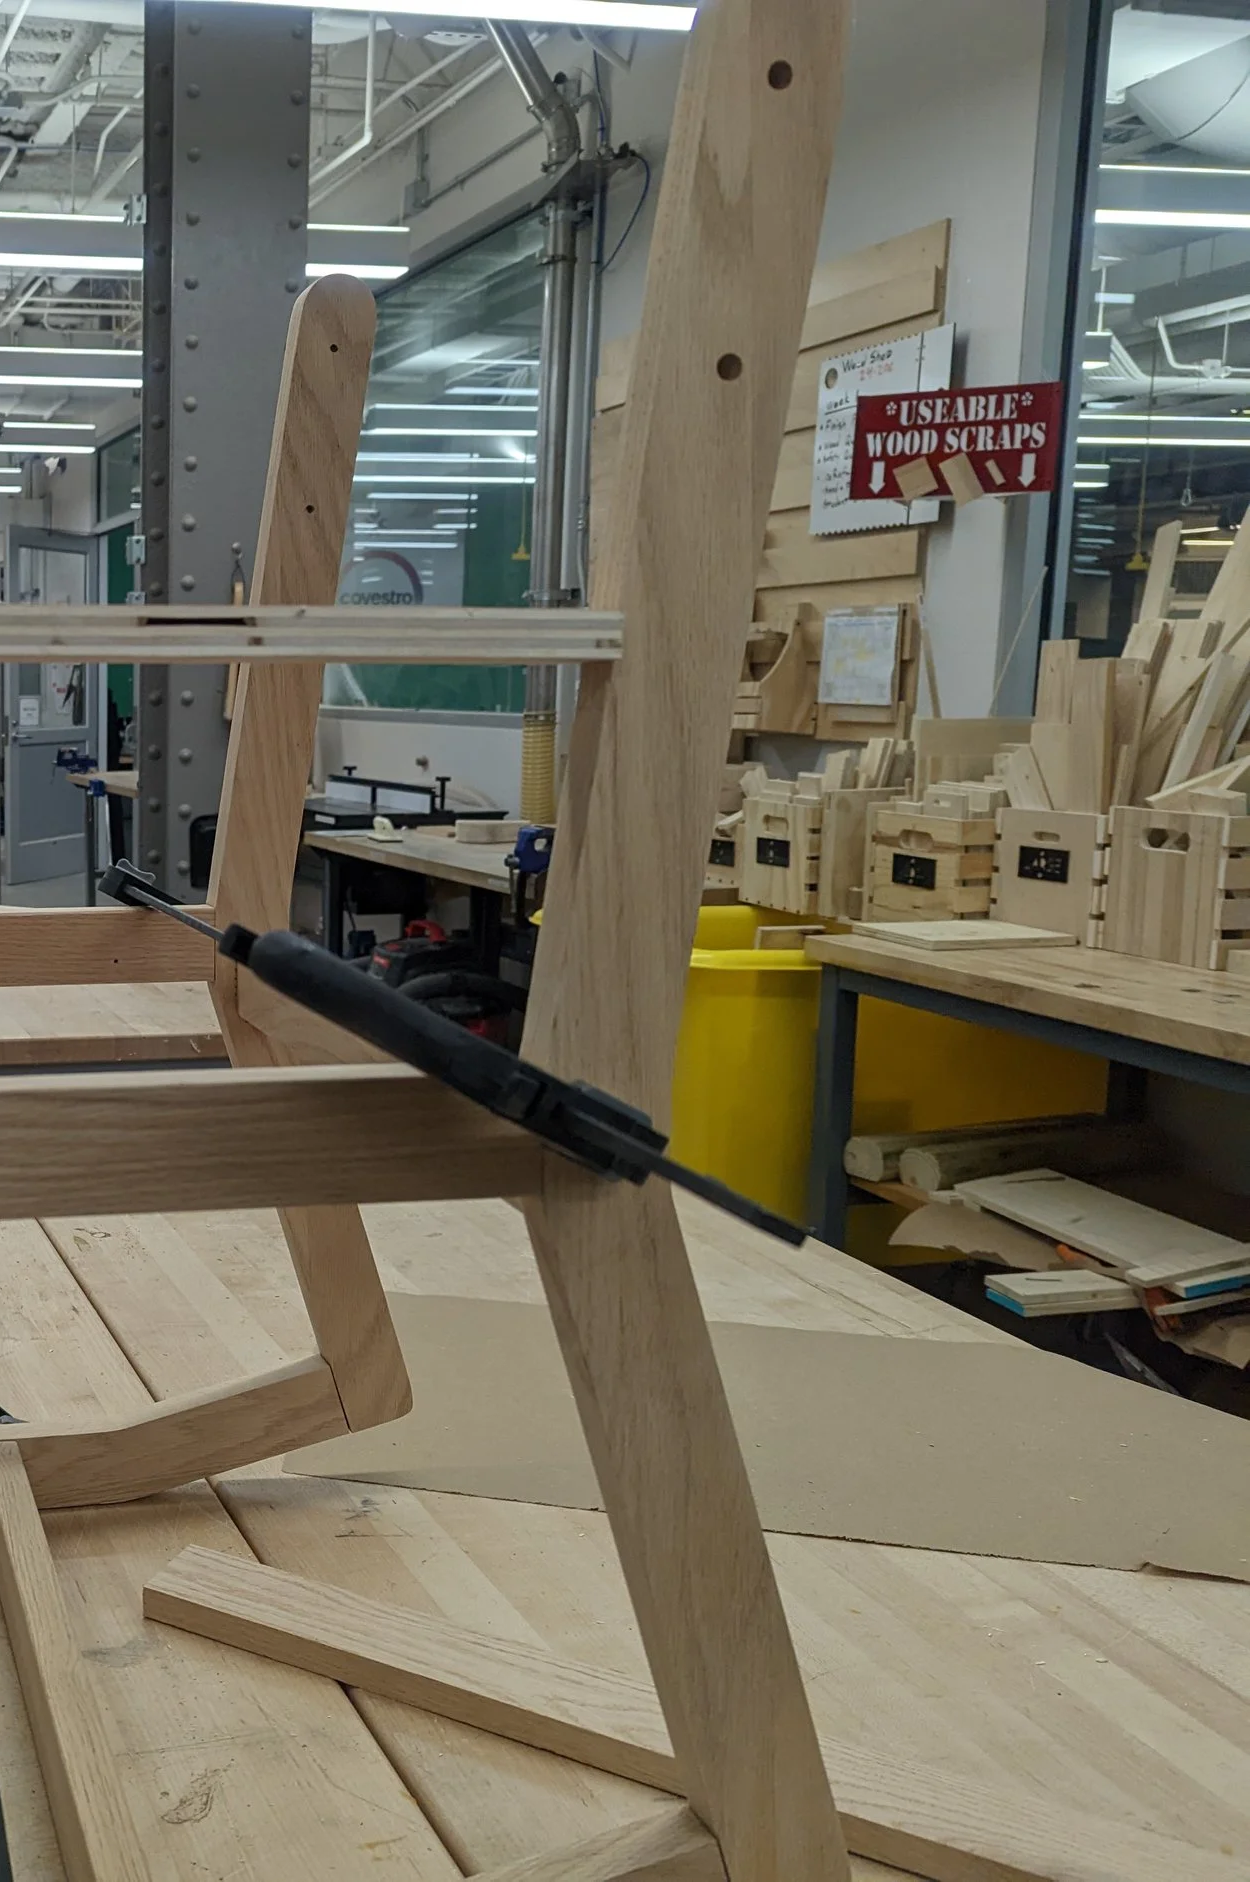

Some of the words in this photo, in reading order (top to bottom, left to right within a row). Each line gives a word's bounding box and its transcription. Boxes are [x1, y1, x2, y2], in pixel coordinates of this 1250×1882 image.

[900, 393, 1019, 427] USEABLE
[866, 429, 939, 458] WOOD
[944, 422, 1047, 454] SCRAPS
[340, 590, 413, 606] covestro
